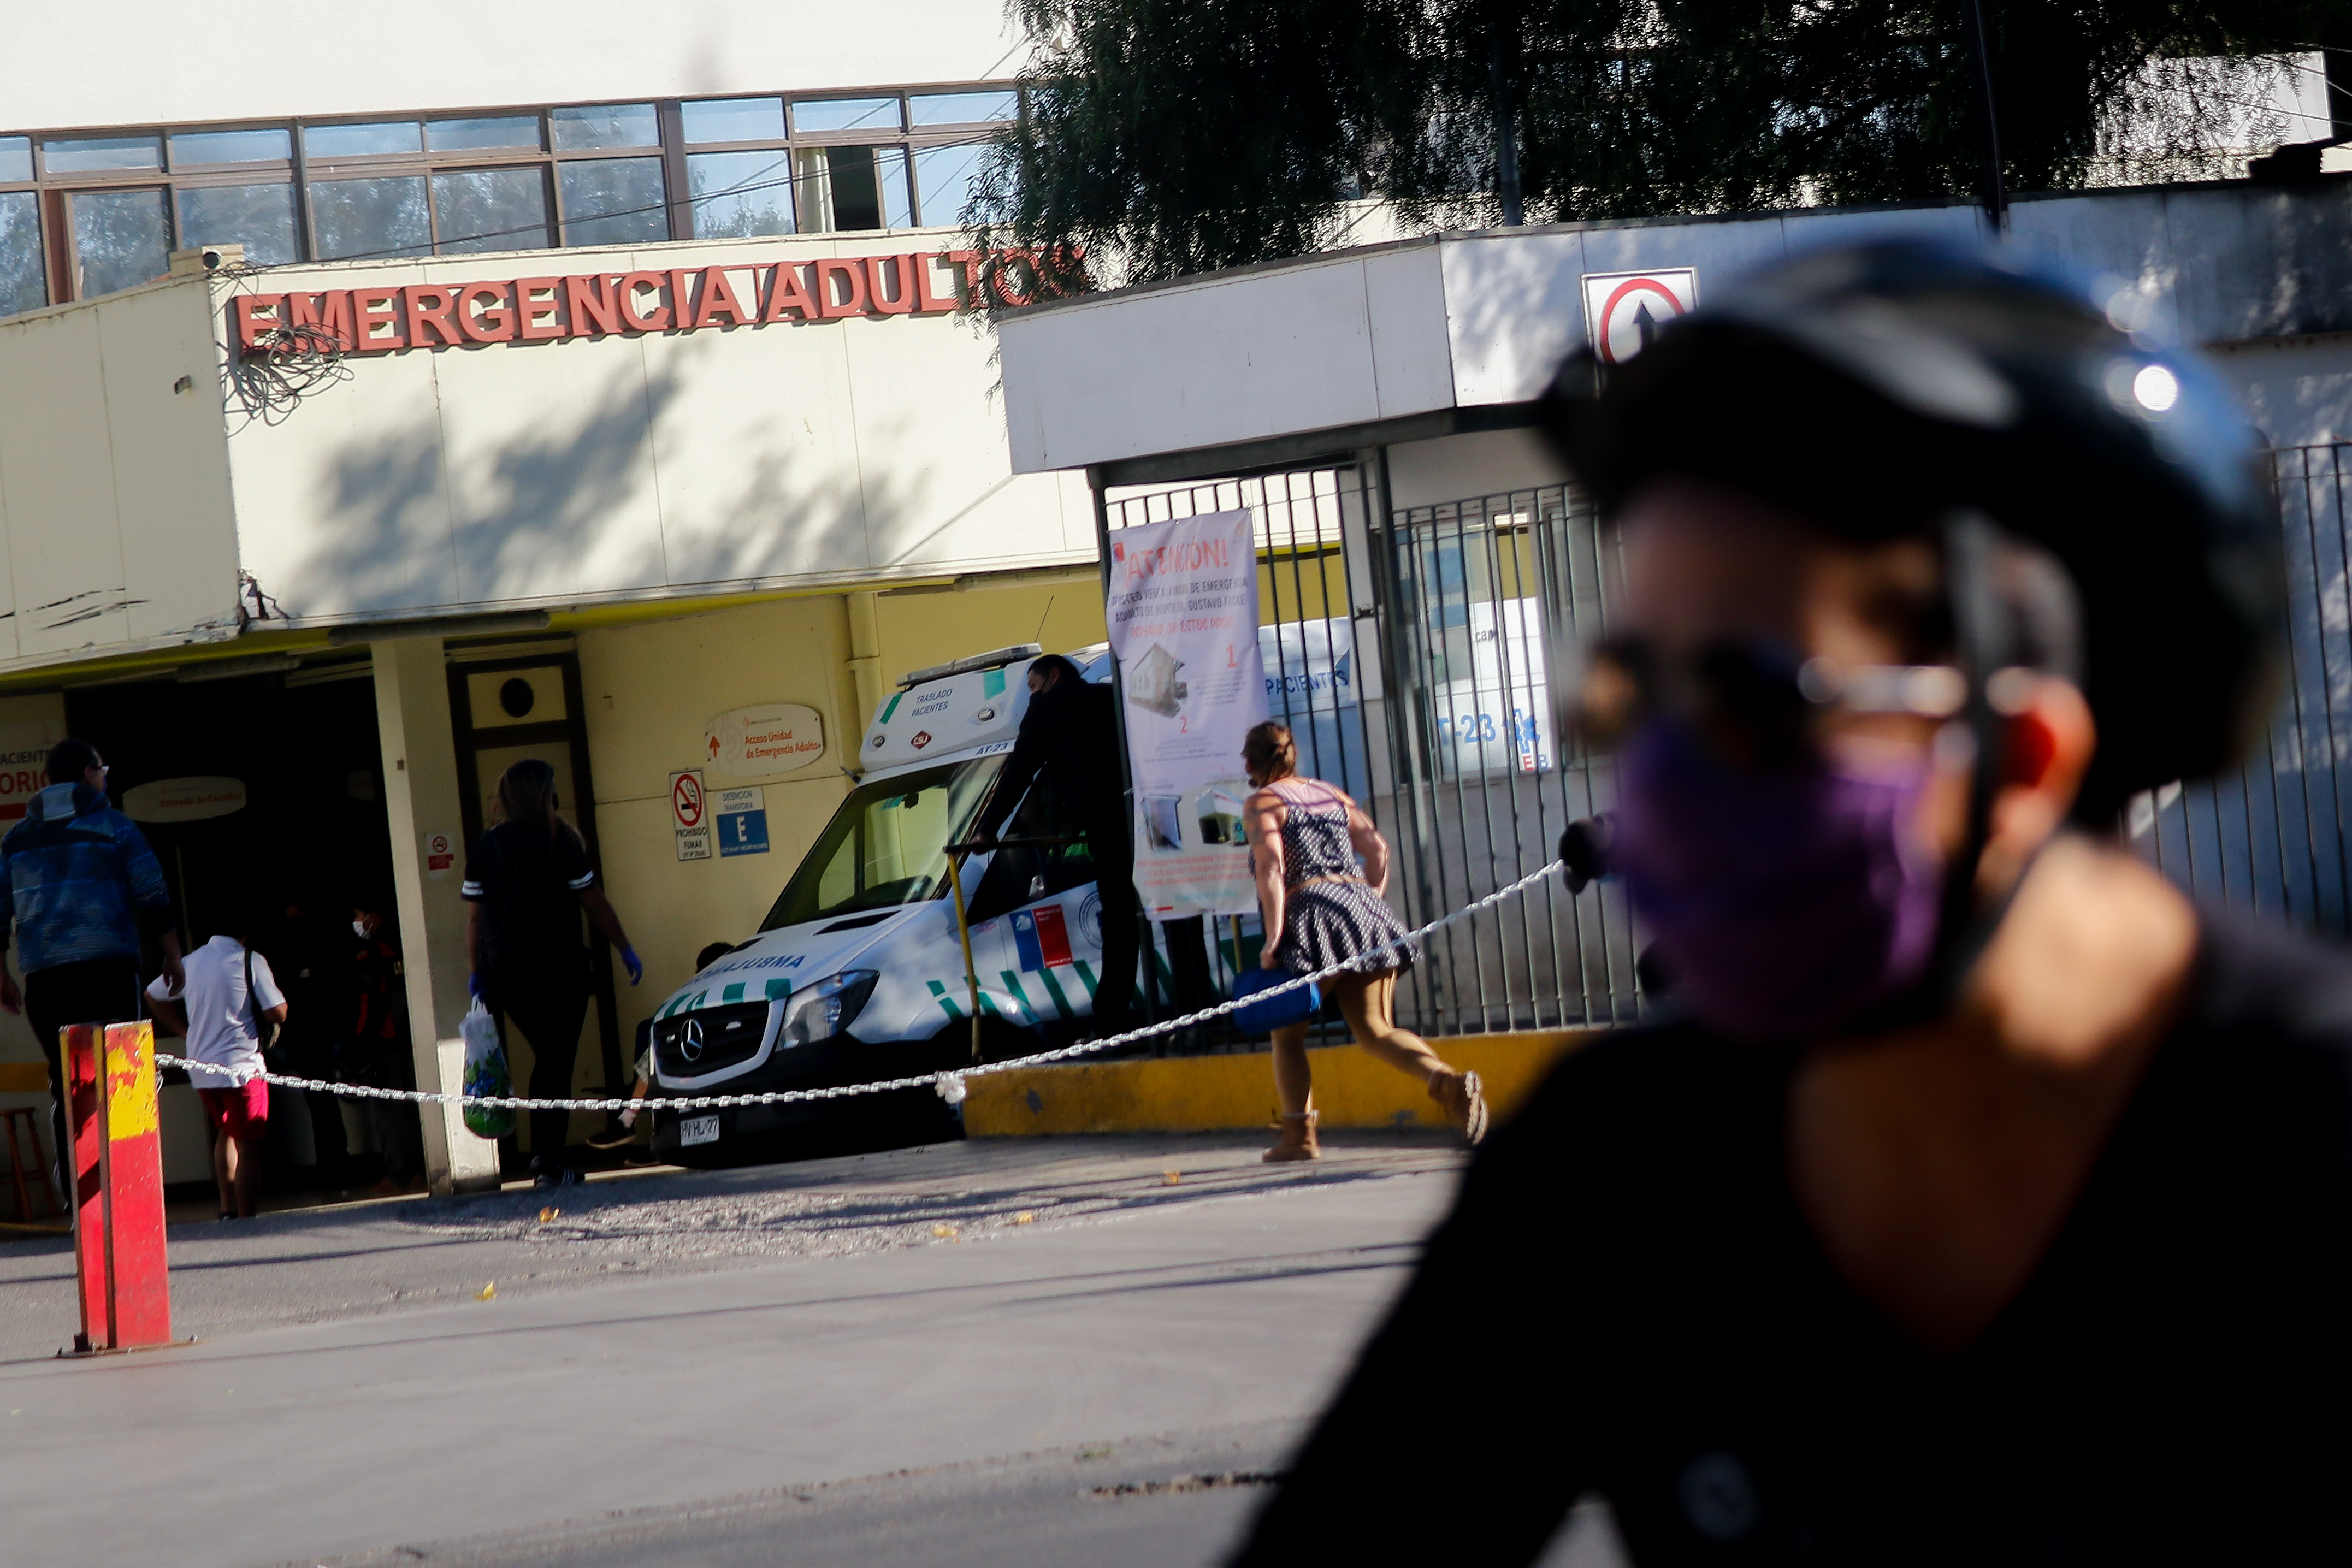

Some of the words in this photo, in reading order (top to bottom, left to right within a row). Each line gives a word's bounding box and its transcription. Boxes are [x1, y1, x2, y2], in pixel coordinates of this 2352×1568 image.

[235, 265, 758, 357] EMERGENCIA
[1190, 582, 1200, 593] DE
[1116, 607, 1143, 623] ADULTO
[1187, 597, 1222, 611] GUSTAVO
[1226, 644, 1237, 668] 1
[916, 688, 953, 705] TRASLADO
[911, 701, 949, 718] PACIENTES
[1180, 716, 1187, 734] 2
[744, 735, 767, 745] Acceso
[768, 729, 793, 742] Unidad
[746, 749, 755, 759] de
[755, 744, 794, 759] Emergencia
[975, 742, 1009, 756] AT-23
[676, 826, 707, 838] PROHIBIDO
[737, 815, 748, 843] E
